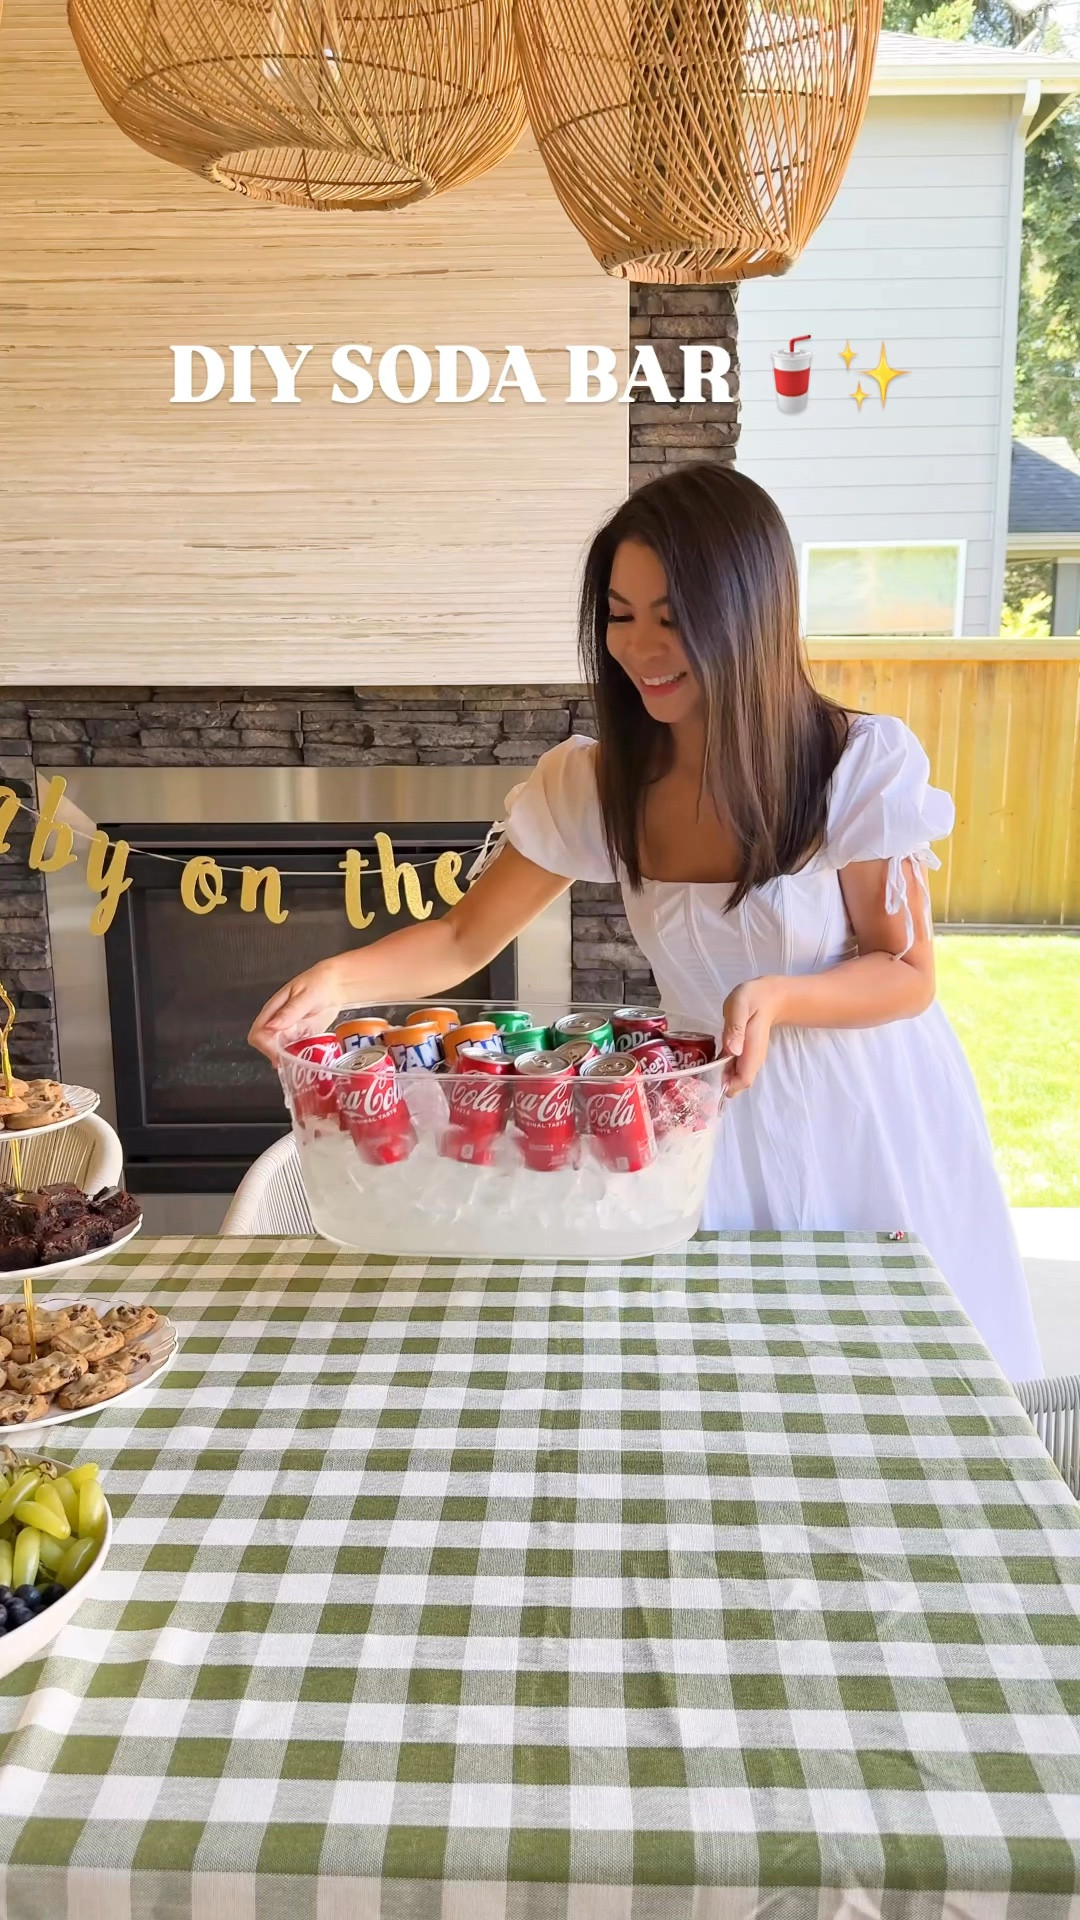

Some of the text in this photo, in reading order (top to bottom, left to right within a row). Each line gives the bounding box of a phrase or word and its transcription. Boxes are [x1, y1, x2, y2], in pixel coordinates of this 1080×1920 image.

[180, 855, 289, 925] on
[338, 831, 478, 930] the
[451, 1070, 503, 1113] Cola
[586, 1086, 637, 1128] Cola
